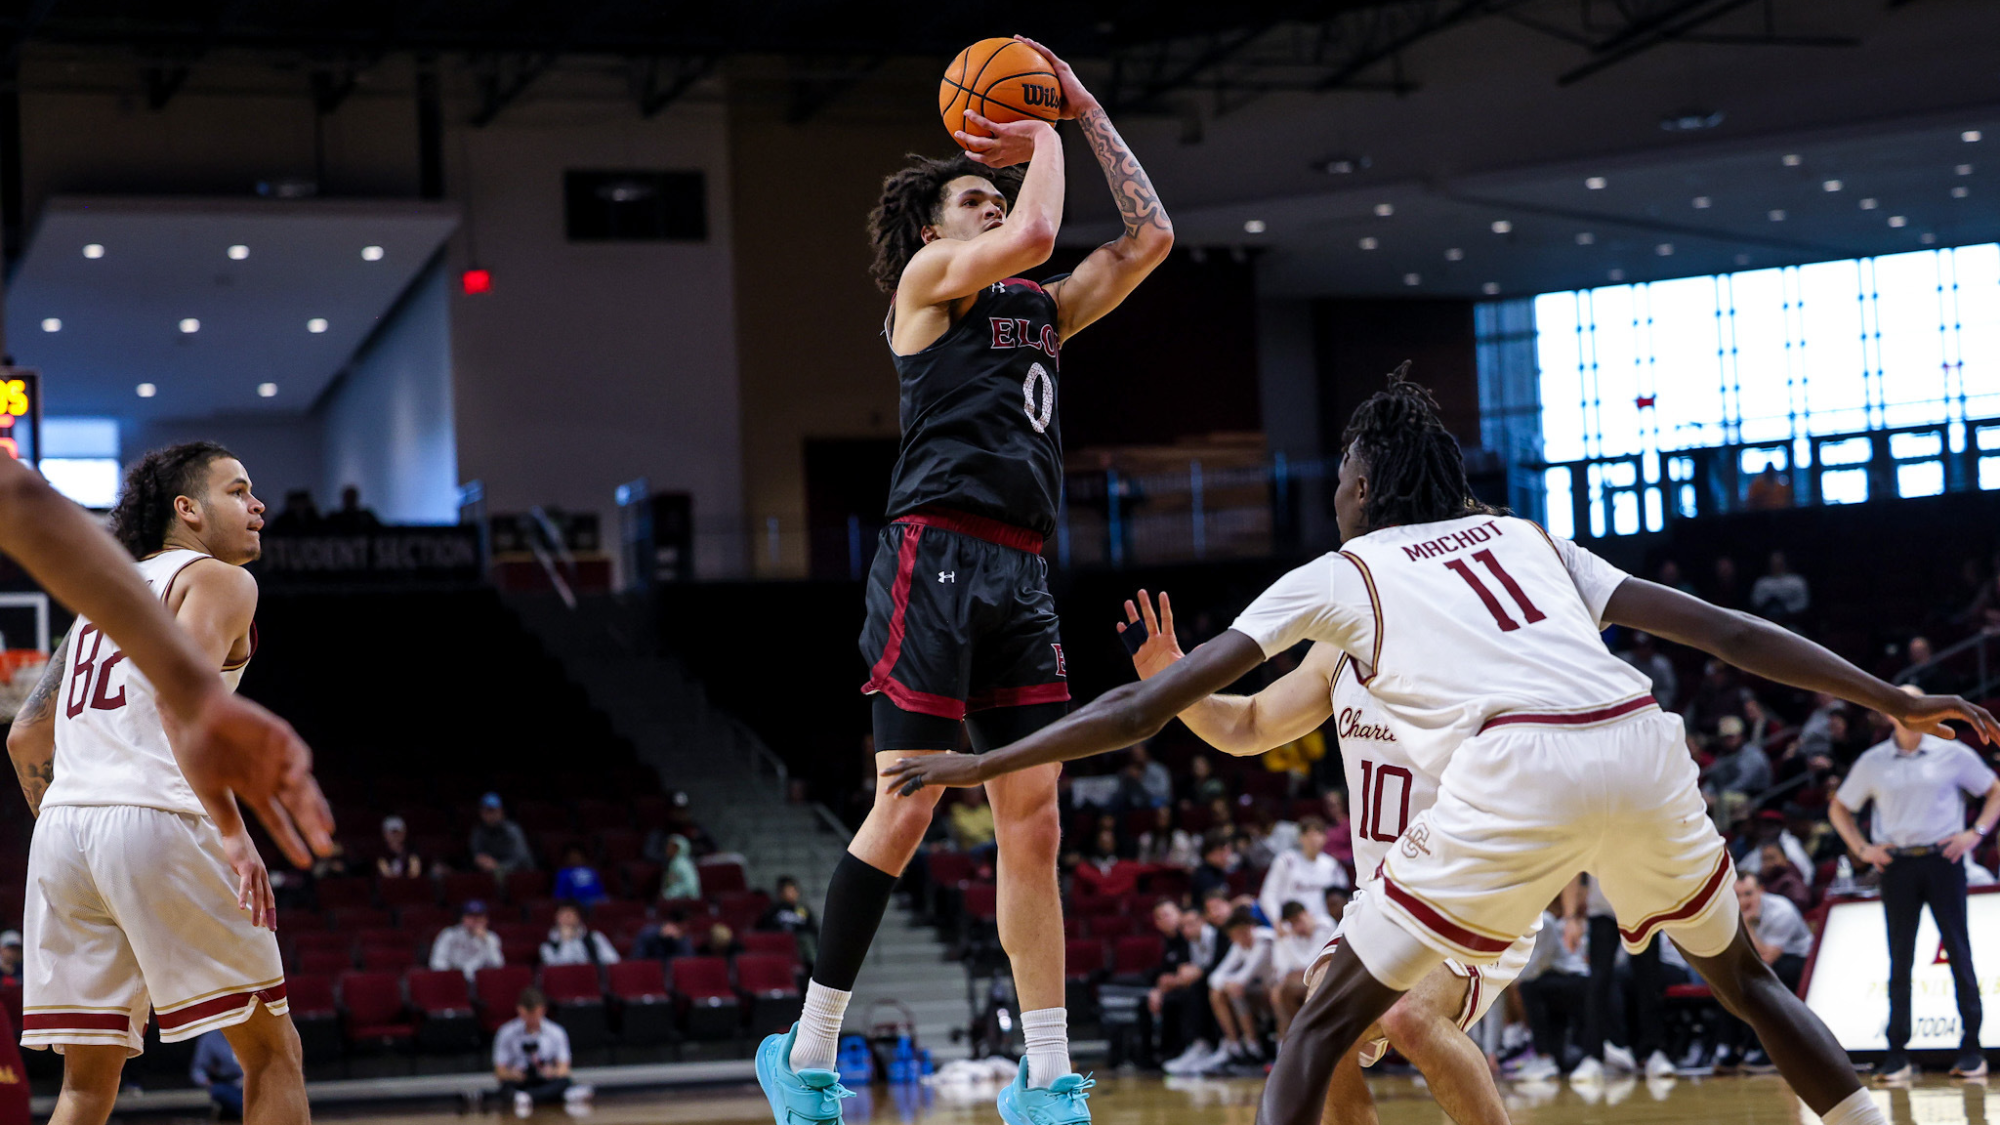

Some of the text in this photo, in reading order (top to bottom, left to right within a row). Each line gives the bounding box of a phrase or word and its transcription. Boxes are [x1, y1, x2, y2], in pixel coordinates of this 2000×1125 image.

[1022, 83, 1061, 109] Wils
[1022, 361, 1054, 434] 0
[1400, 520, 1504, 562] MACHOT
[1442, 548, 1548, 633] 11
[1359, 759, 1413, 844] 10
[1912, 1016, 1962, 1039] TODA
